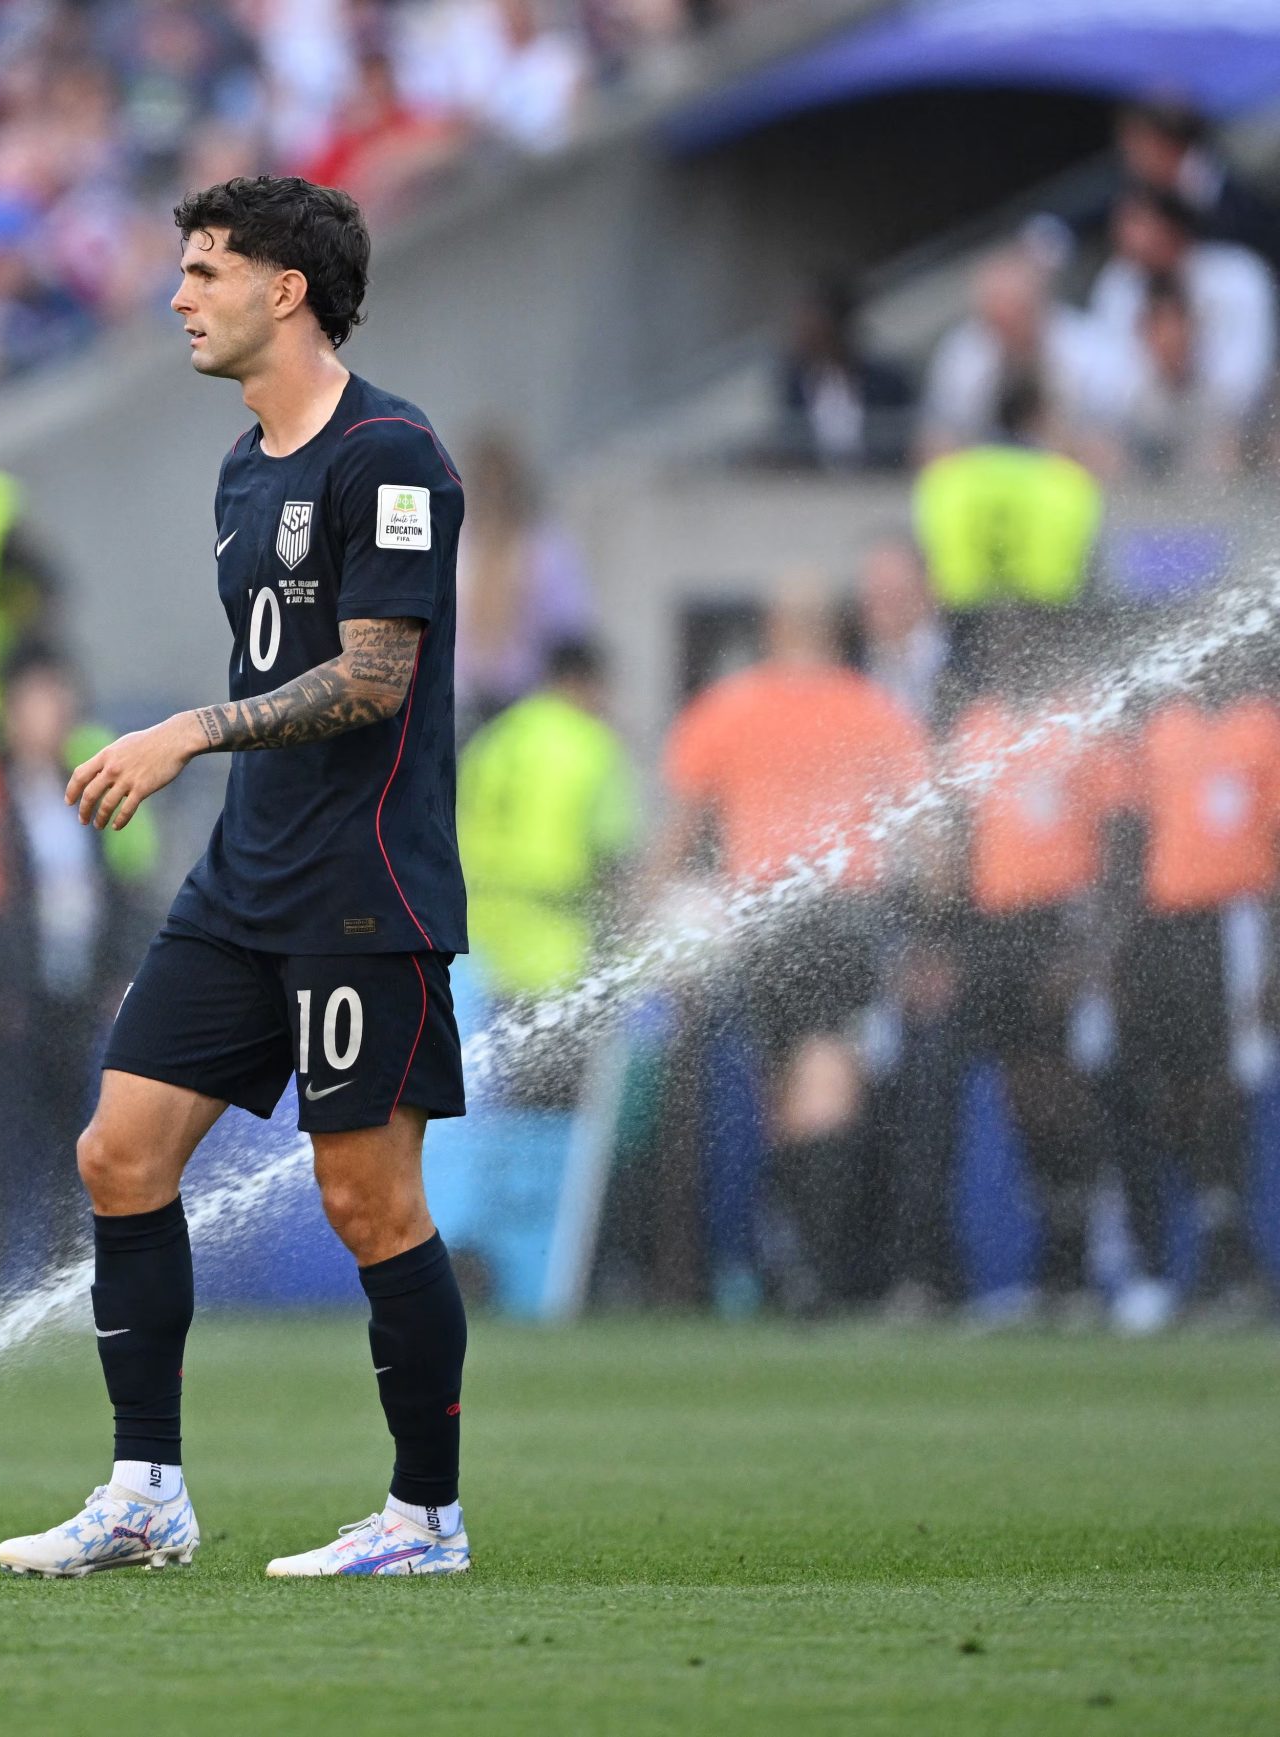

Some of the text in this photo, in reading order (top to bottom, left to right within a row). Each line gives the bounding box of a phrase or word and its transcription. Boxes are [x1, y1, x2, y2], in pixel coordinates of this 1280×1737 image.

[283, 506, 310, 531] USA
[390, 513, 419, 524] Unite For
[385, 525, 423, 535] EDUCATION
[283, 588, 305, 596] SEATTLE,
[286, 596, 291, 604] 6
[291, 596, 303, 604] JULY
[296, 985, 364, 1075] 10
[149, 1461, 162, 1488] IGN
